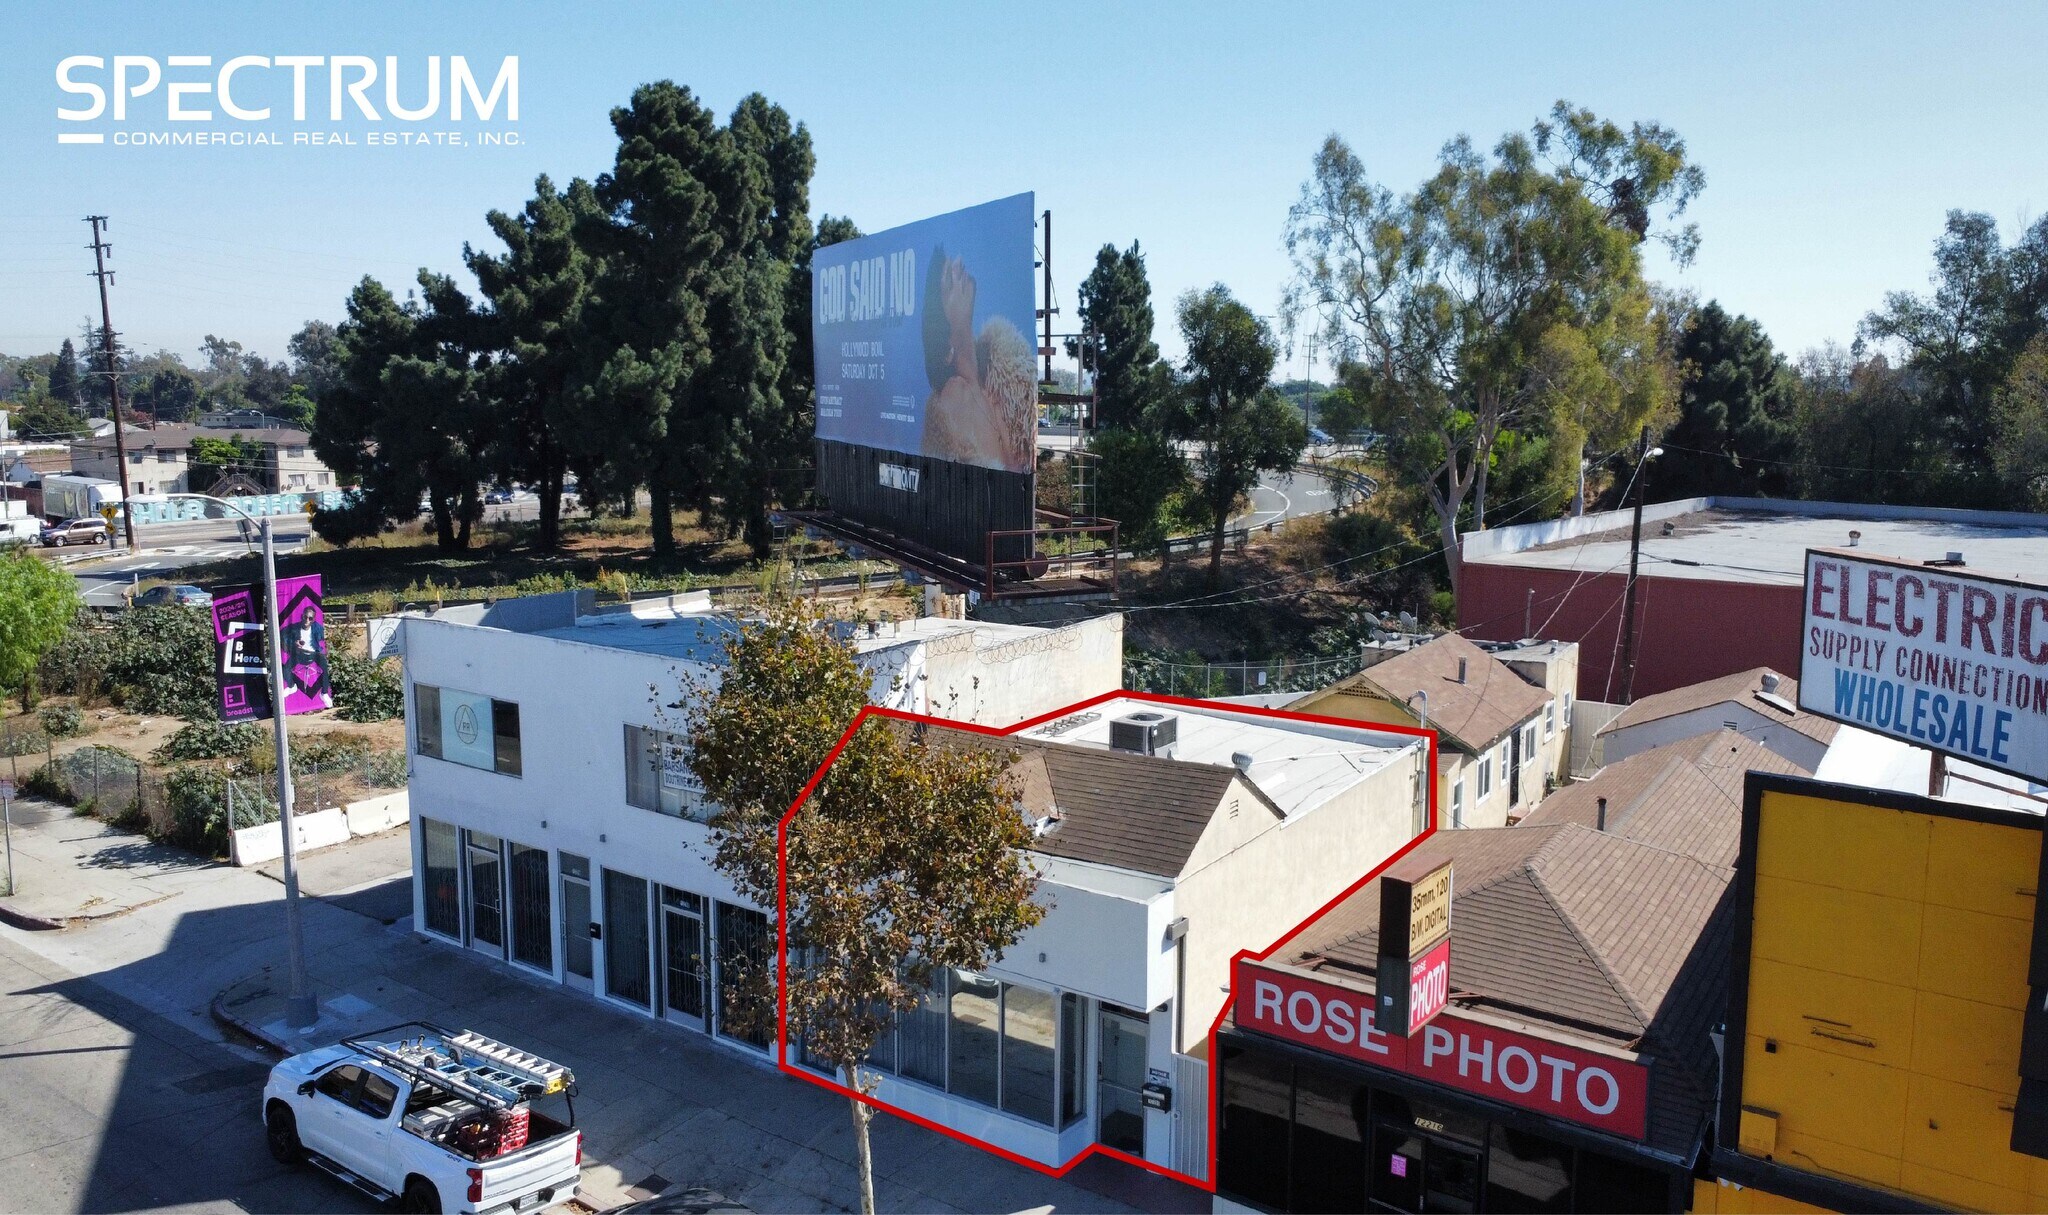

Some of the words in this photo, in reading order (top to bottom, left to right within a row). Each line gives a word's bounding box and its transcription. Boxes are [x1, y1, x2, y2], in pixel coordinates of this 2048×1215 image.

[819, 264, 847, 325] GOD
[849, 256, 886, 322] SAID
[889, 248, 916, 318] NO
[841, 341, 869, 358] HOLLYWOOD
[870, 341, 885, 357] BOWL
[841, 363, 867, 379] SATURDAY
[868, 364, 878, 380] OCT
[880, 364, 886, 380] 5
[220, 608, 247, 621] SEASON
[1811, 560, 2048, 667] ELECTRIC
[235, 641, 244, 651] B
[234, 653, 263, 664] Here.
[1809, 626, 1887, 674] SUPPLY
[1896, 645, 2048, 716] CONNECTION
[1834, 667, 2013, 764] WHOLESALE
[1436, 876, 1448, 896] 120
[1424, 906, 1447, 932] DIGITAL
[1412, 959, 1427, 978] ROSE
[1410, 960, 1447, 1027] PHOTO
[1254, 979, 1389, 1055] ROSE
[1423, 1026, 1620, 1115] PHOTO
[1415, 1117, 1443, 1131] 12216
